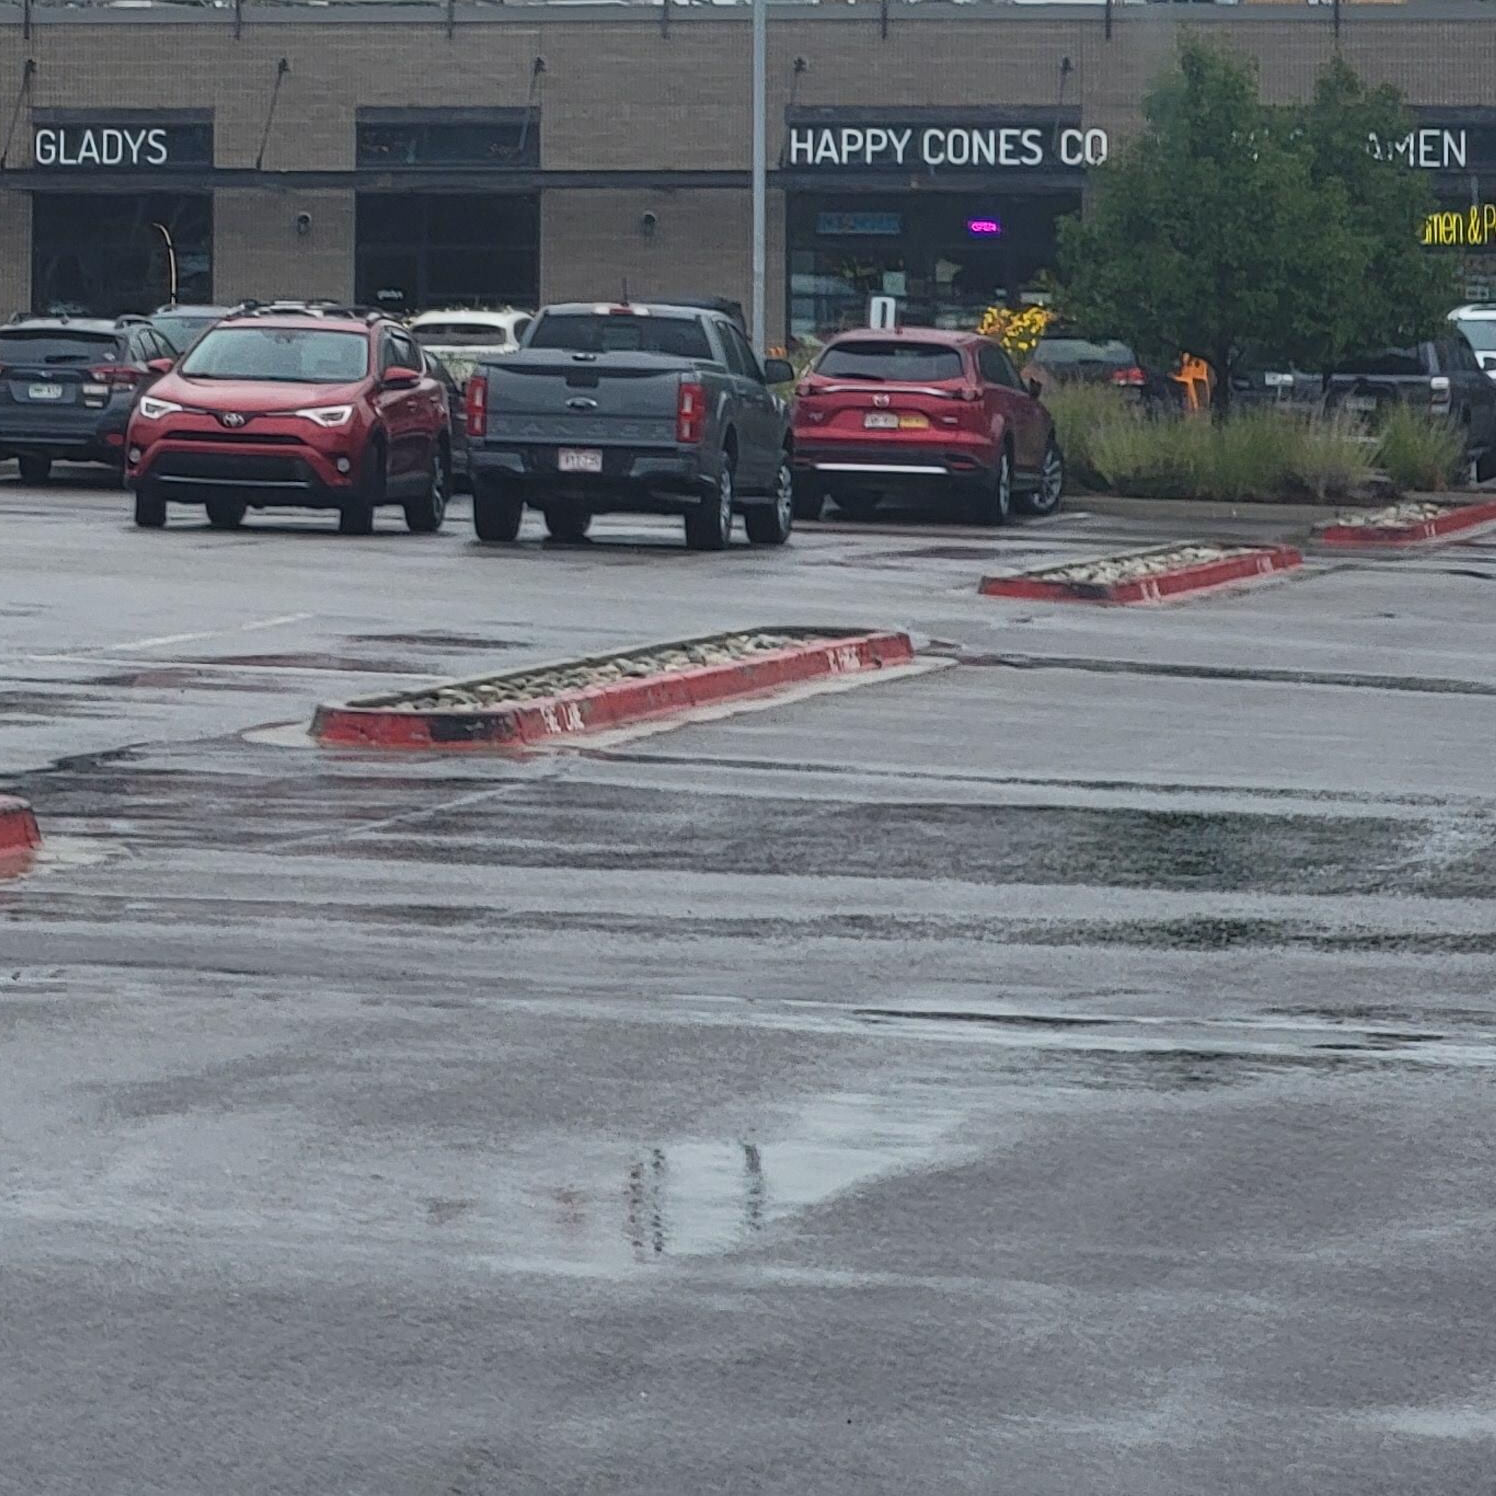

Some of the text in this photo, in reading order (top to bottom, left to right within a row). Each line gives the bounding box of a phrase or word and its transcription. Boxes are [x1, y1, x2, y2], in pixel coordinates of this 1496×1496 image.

[35, 128, 168, 165] GLADYS
[790, 128, 1108, 166] HAPPY CONES CO
[1467, 204, 1483, 245] &
